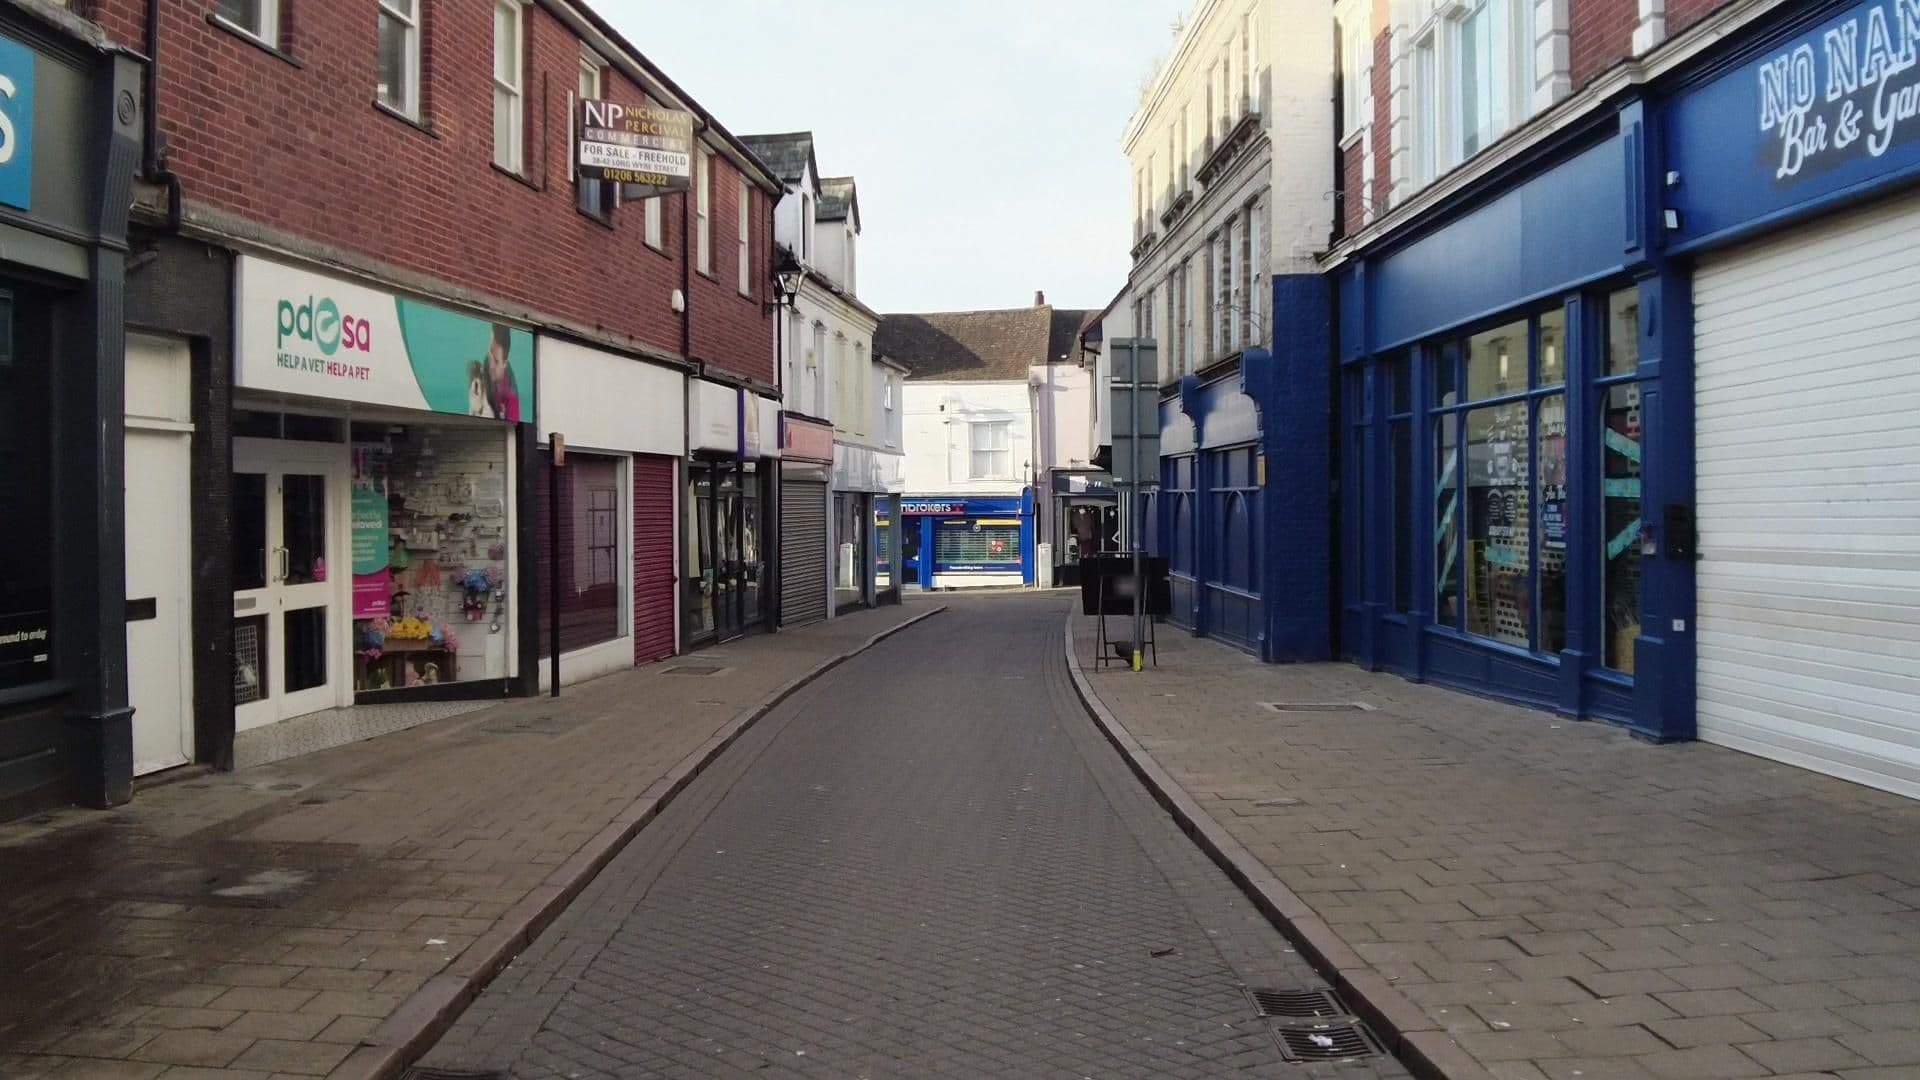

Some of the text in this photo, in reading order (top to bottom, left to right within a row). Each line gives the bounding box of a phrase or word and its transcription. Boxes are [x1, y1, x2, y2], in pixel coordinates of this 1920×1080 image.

[1759, 43, 1816, 131] NO
[585, 100, 688, 128] NP NICHOLAS
[586, 128, 685, 149] COMMERCIAL
[625, 120, 685, 136] PERCIVAL
[1776, 107, 1828, 180] Bar
[1834, 100, 1864, 149] &
[584, 144, 603, 155] FOR
[606, 147, 630, 159] SALE
[638, 151, 687, 166] FREEHOLD
[277, 353, 370, 380] HELP A VET HELP A PET
